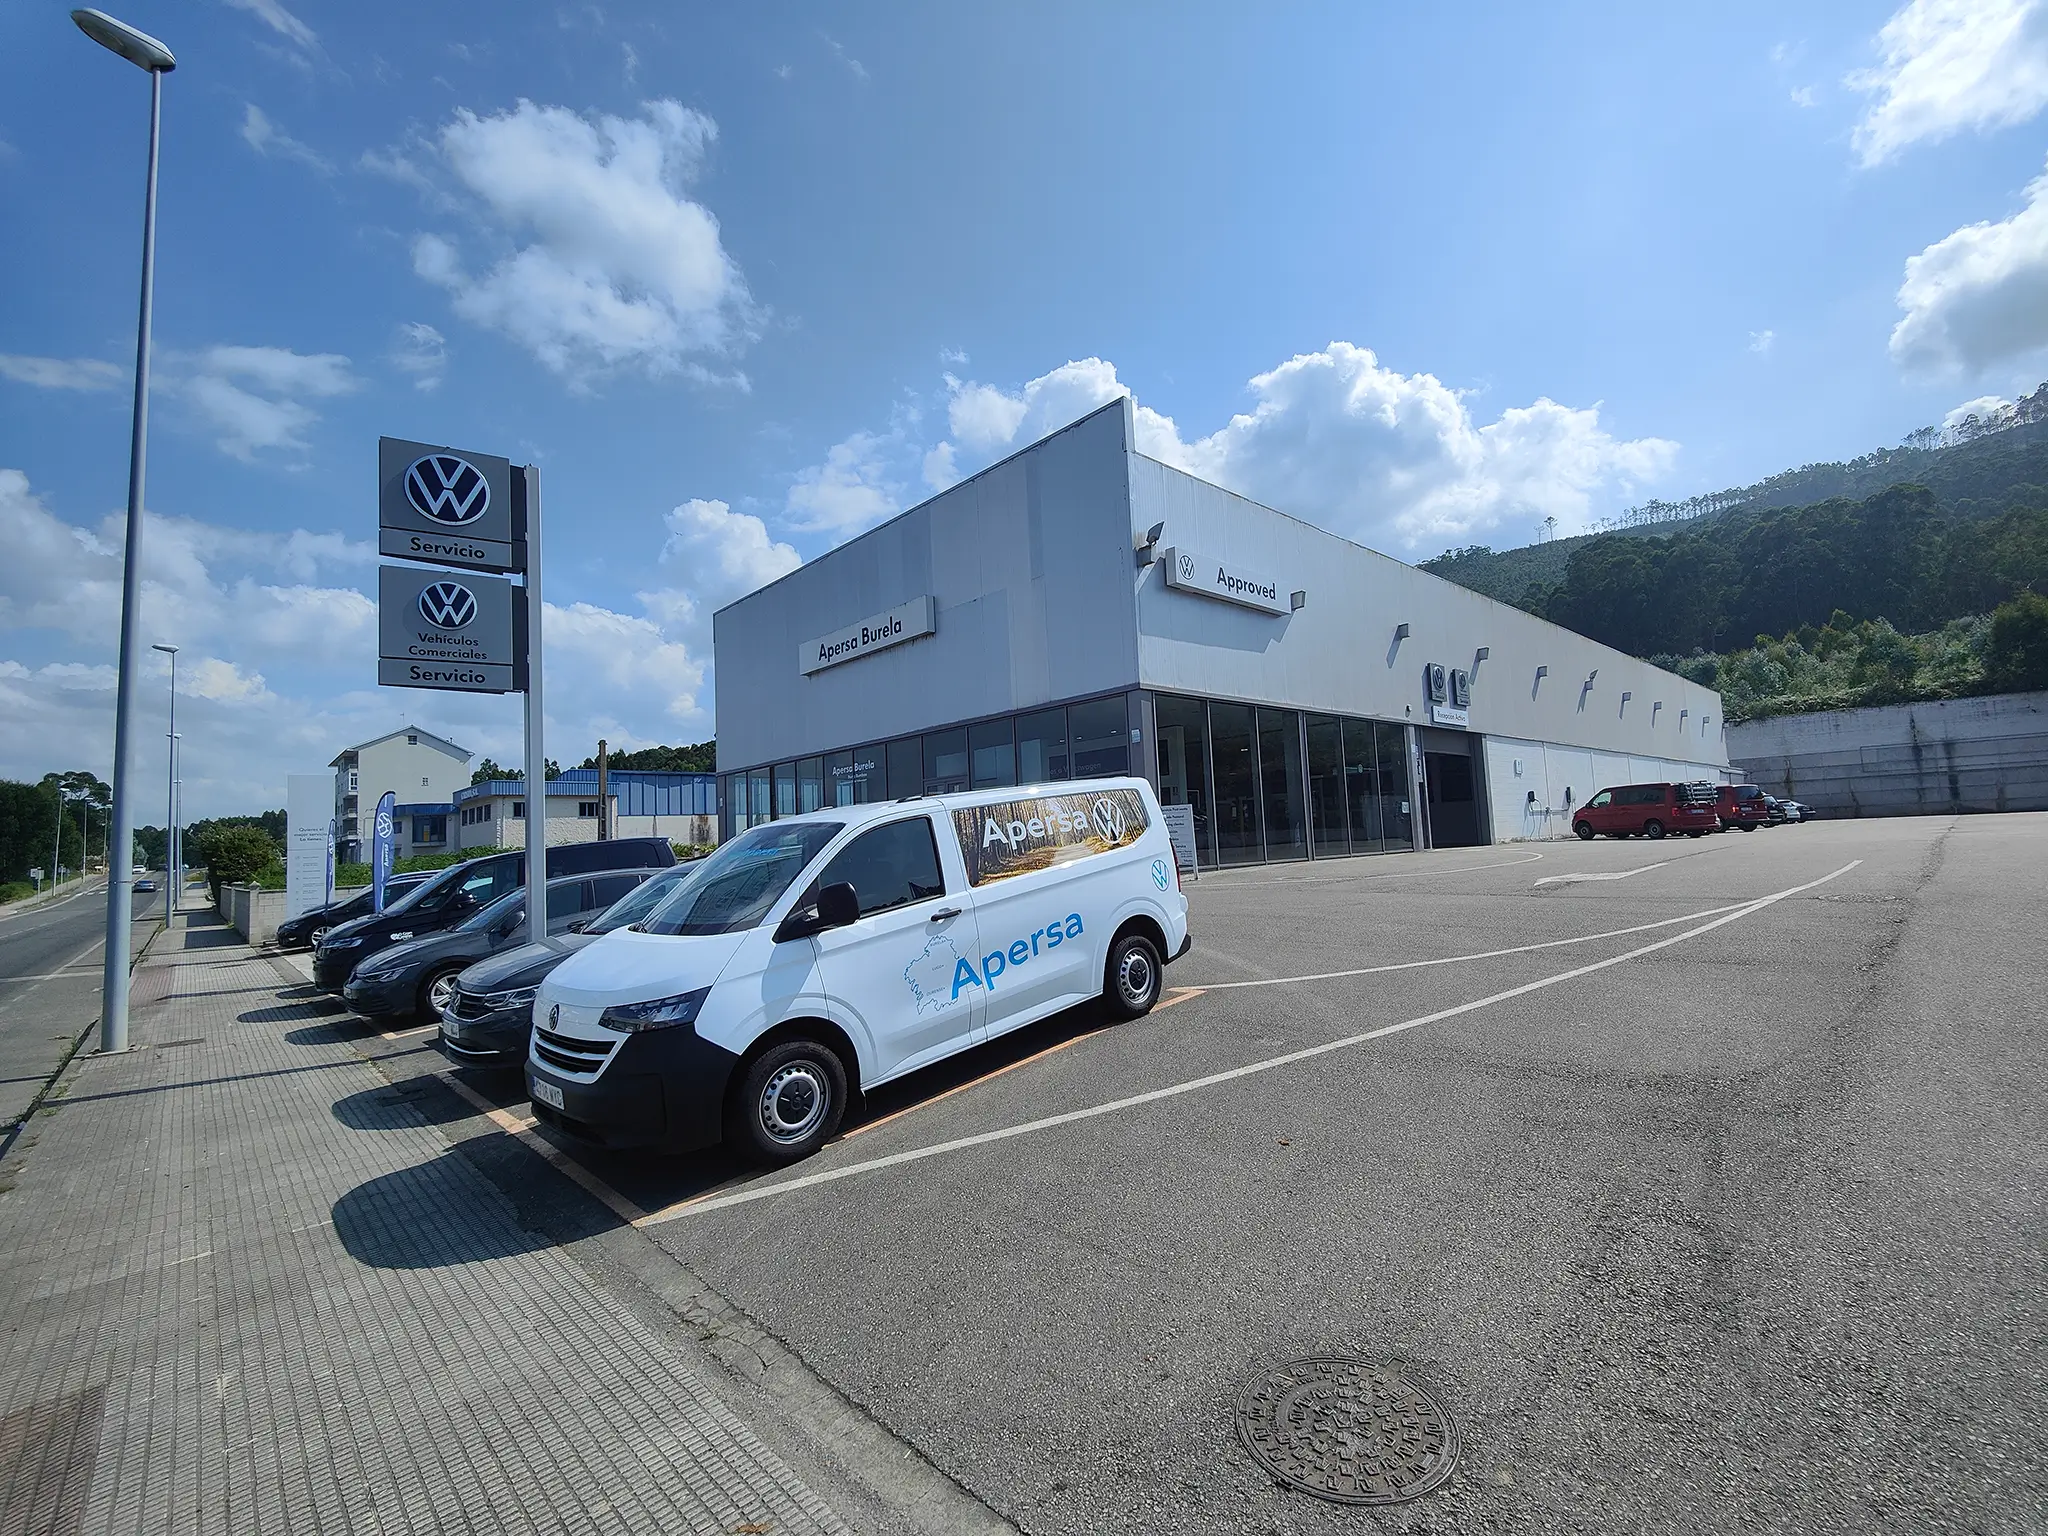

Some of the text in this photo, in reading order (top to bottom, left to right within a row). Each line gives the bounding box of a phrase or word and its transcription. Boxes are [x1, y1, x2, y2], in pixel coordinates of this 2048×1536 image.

[410, 536, 485, 559] Servicio
[1217, 567, 1276, 600] Approved
[418, 632, 479, 647] Vehículos
[818, 616, 902, 662] Apersa Burela
[408, 645, 488, 660] Comerciales
[409, 665, 486, 684] Servicio
[832, 766, 853, 776] Apersa
[854, 760, 875, 771] Burela
[982, 809, 1088, 850] Apersa
[951, 912, 1084, 1001] Apersa
